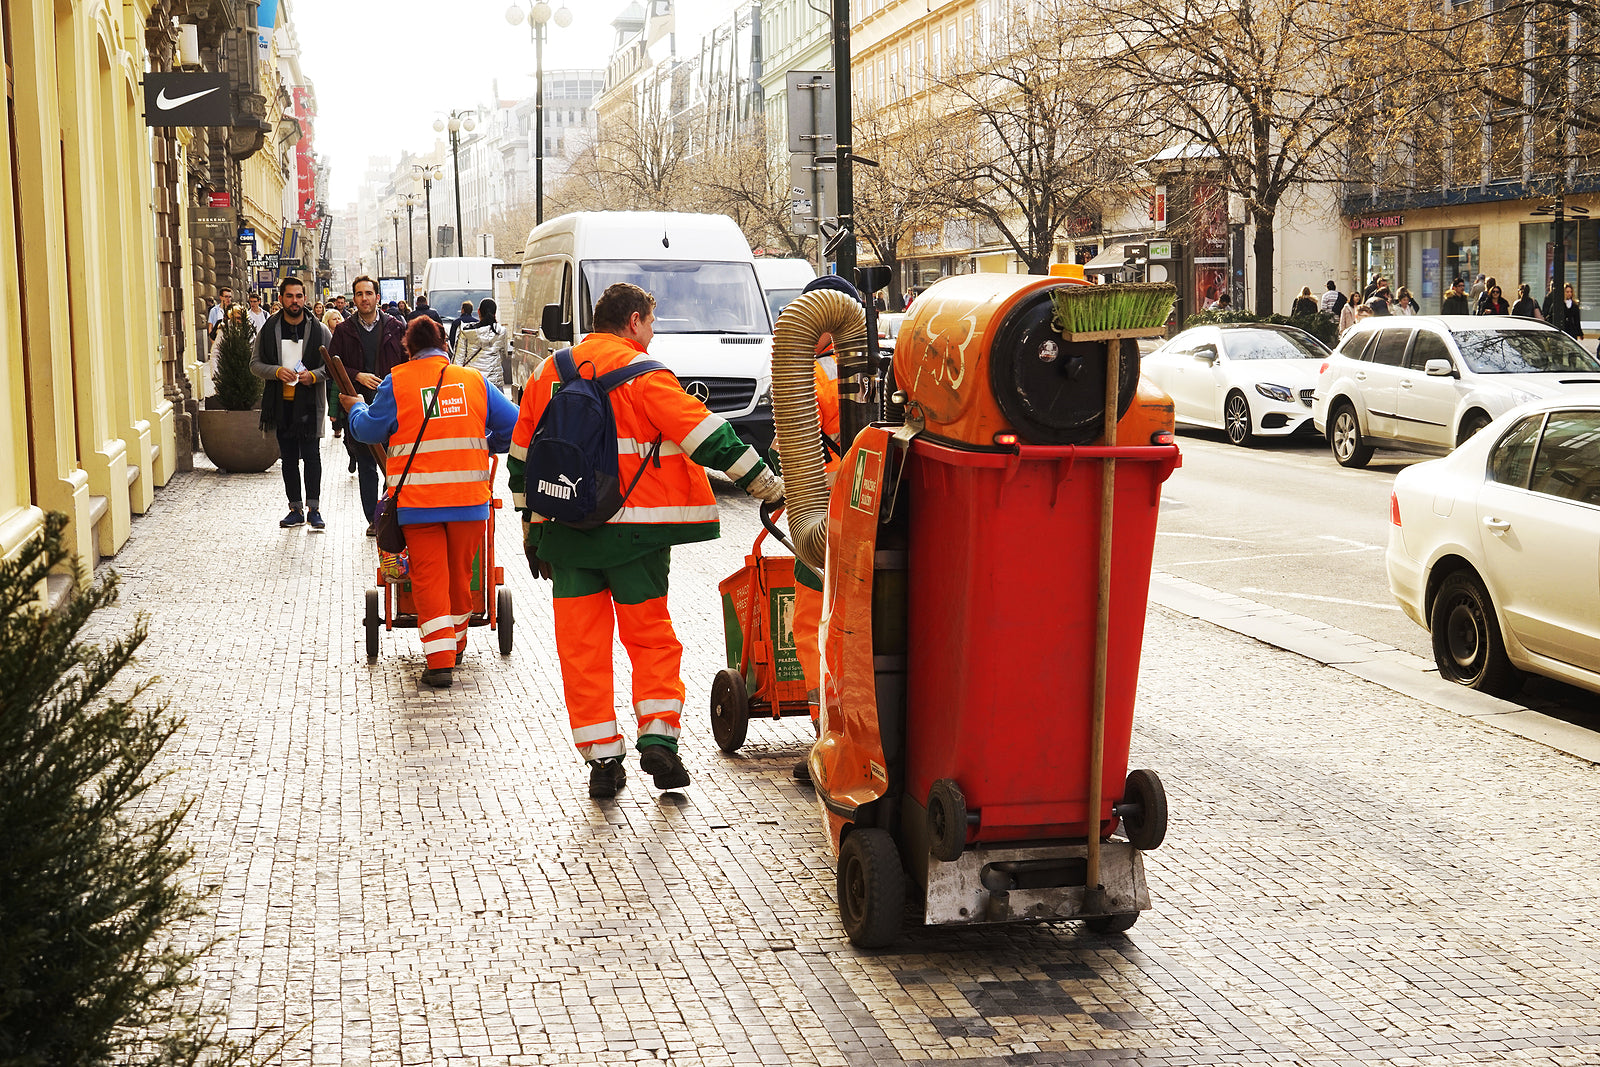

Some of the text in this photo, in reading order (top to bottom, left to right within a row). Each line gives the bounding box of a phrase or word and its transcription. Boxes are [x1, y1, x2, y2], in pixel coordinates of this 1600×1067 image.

[1361, 217, 1379, 228] PRAGUE
[1380, 215, 1400, 227] MARKET
[1150, 247, 1160, 255] WC
[537, 479, 572, 500] PUMA
